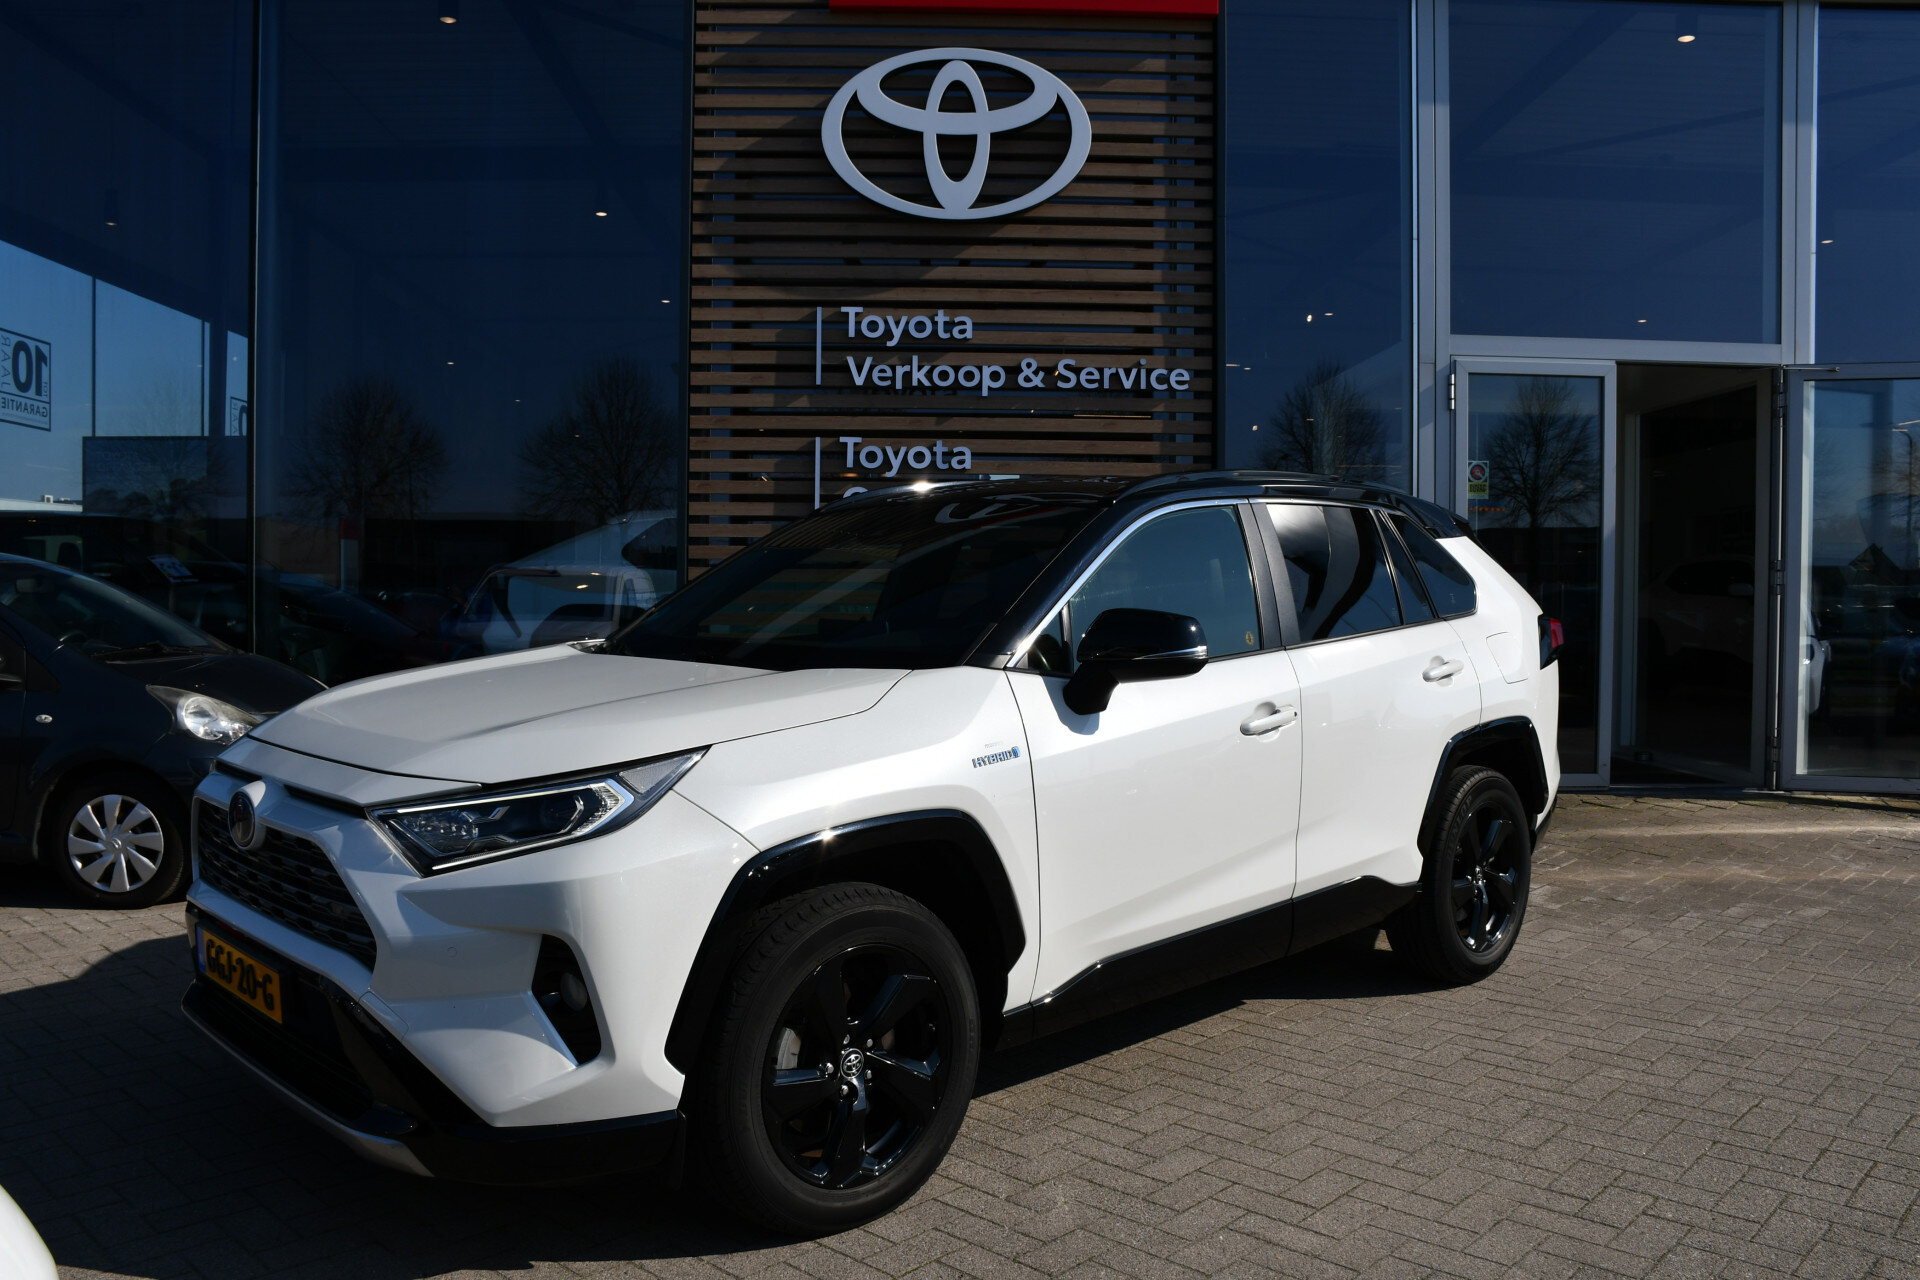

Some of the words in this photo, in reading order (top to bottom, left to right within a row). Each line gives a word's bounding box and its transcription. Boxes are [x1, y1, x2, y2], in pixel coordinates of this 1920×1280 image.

[840, 306, 974, 347] Toyota
[846, 355, 1006, 397] Verkoop
[1017, 357, 1046, 388] &
[1056, 358, 1191, 391] Service
[839, 436, 973, 478] Toyota
[972, 750, 1012, 768] HYBRID
[206, 939, 274, 1010] GGJ-20-G
